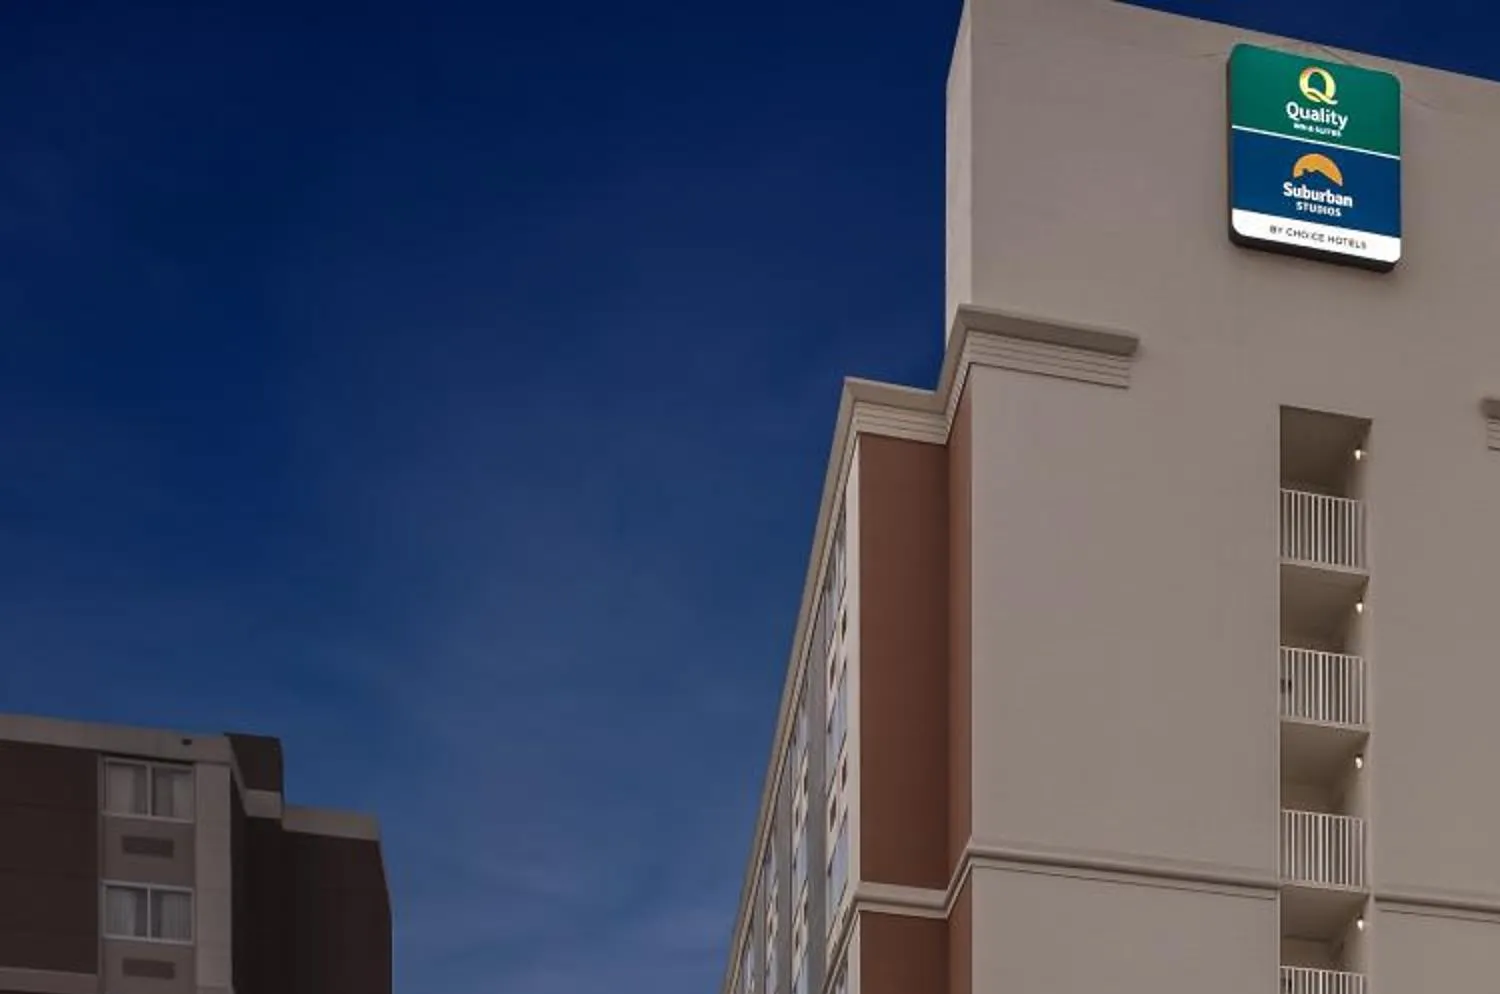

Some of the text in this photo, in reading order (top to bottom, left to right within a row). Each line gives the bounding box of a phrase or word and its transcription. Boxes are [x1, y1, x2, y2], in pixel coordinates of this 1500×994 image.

[1299, 67, 1338, 105] Q
[1286, 101, 1348, 130] Quality
[1283, 181, 1353, 208] Suburban
[1296, 201, 1342, 217] STUDIOS
[1269, 225, 1367, 250] BY CHOICE HOTELS
